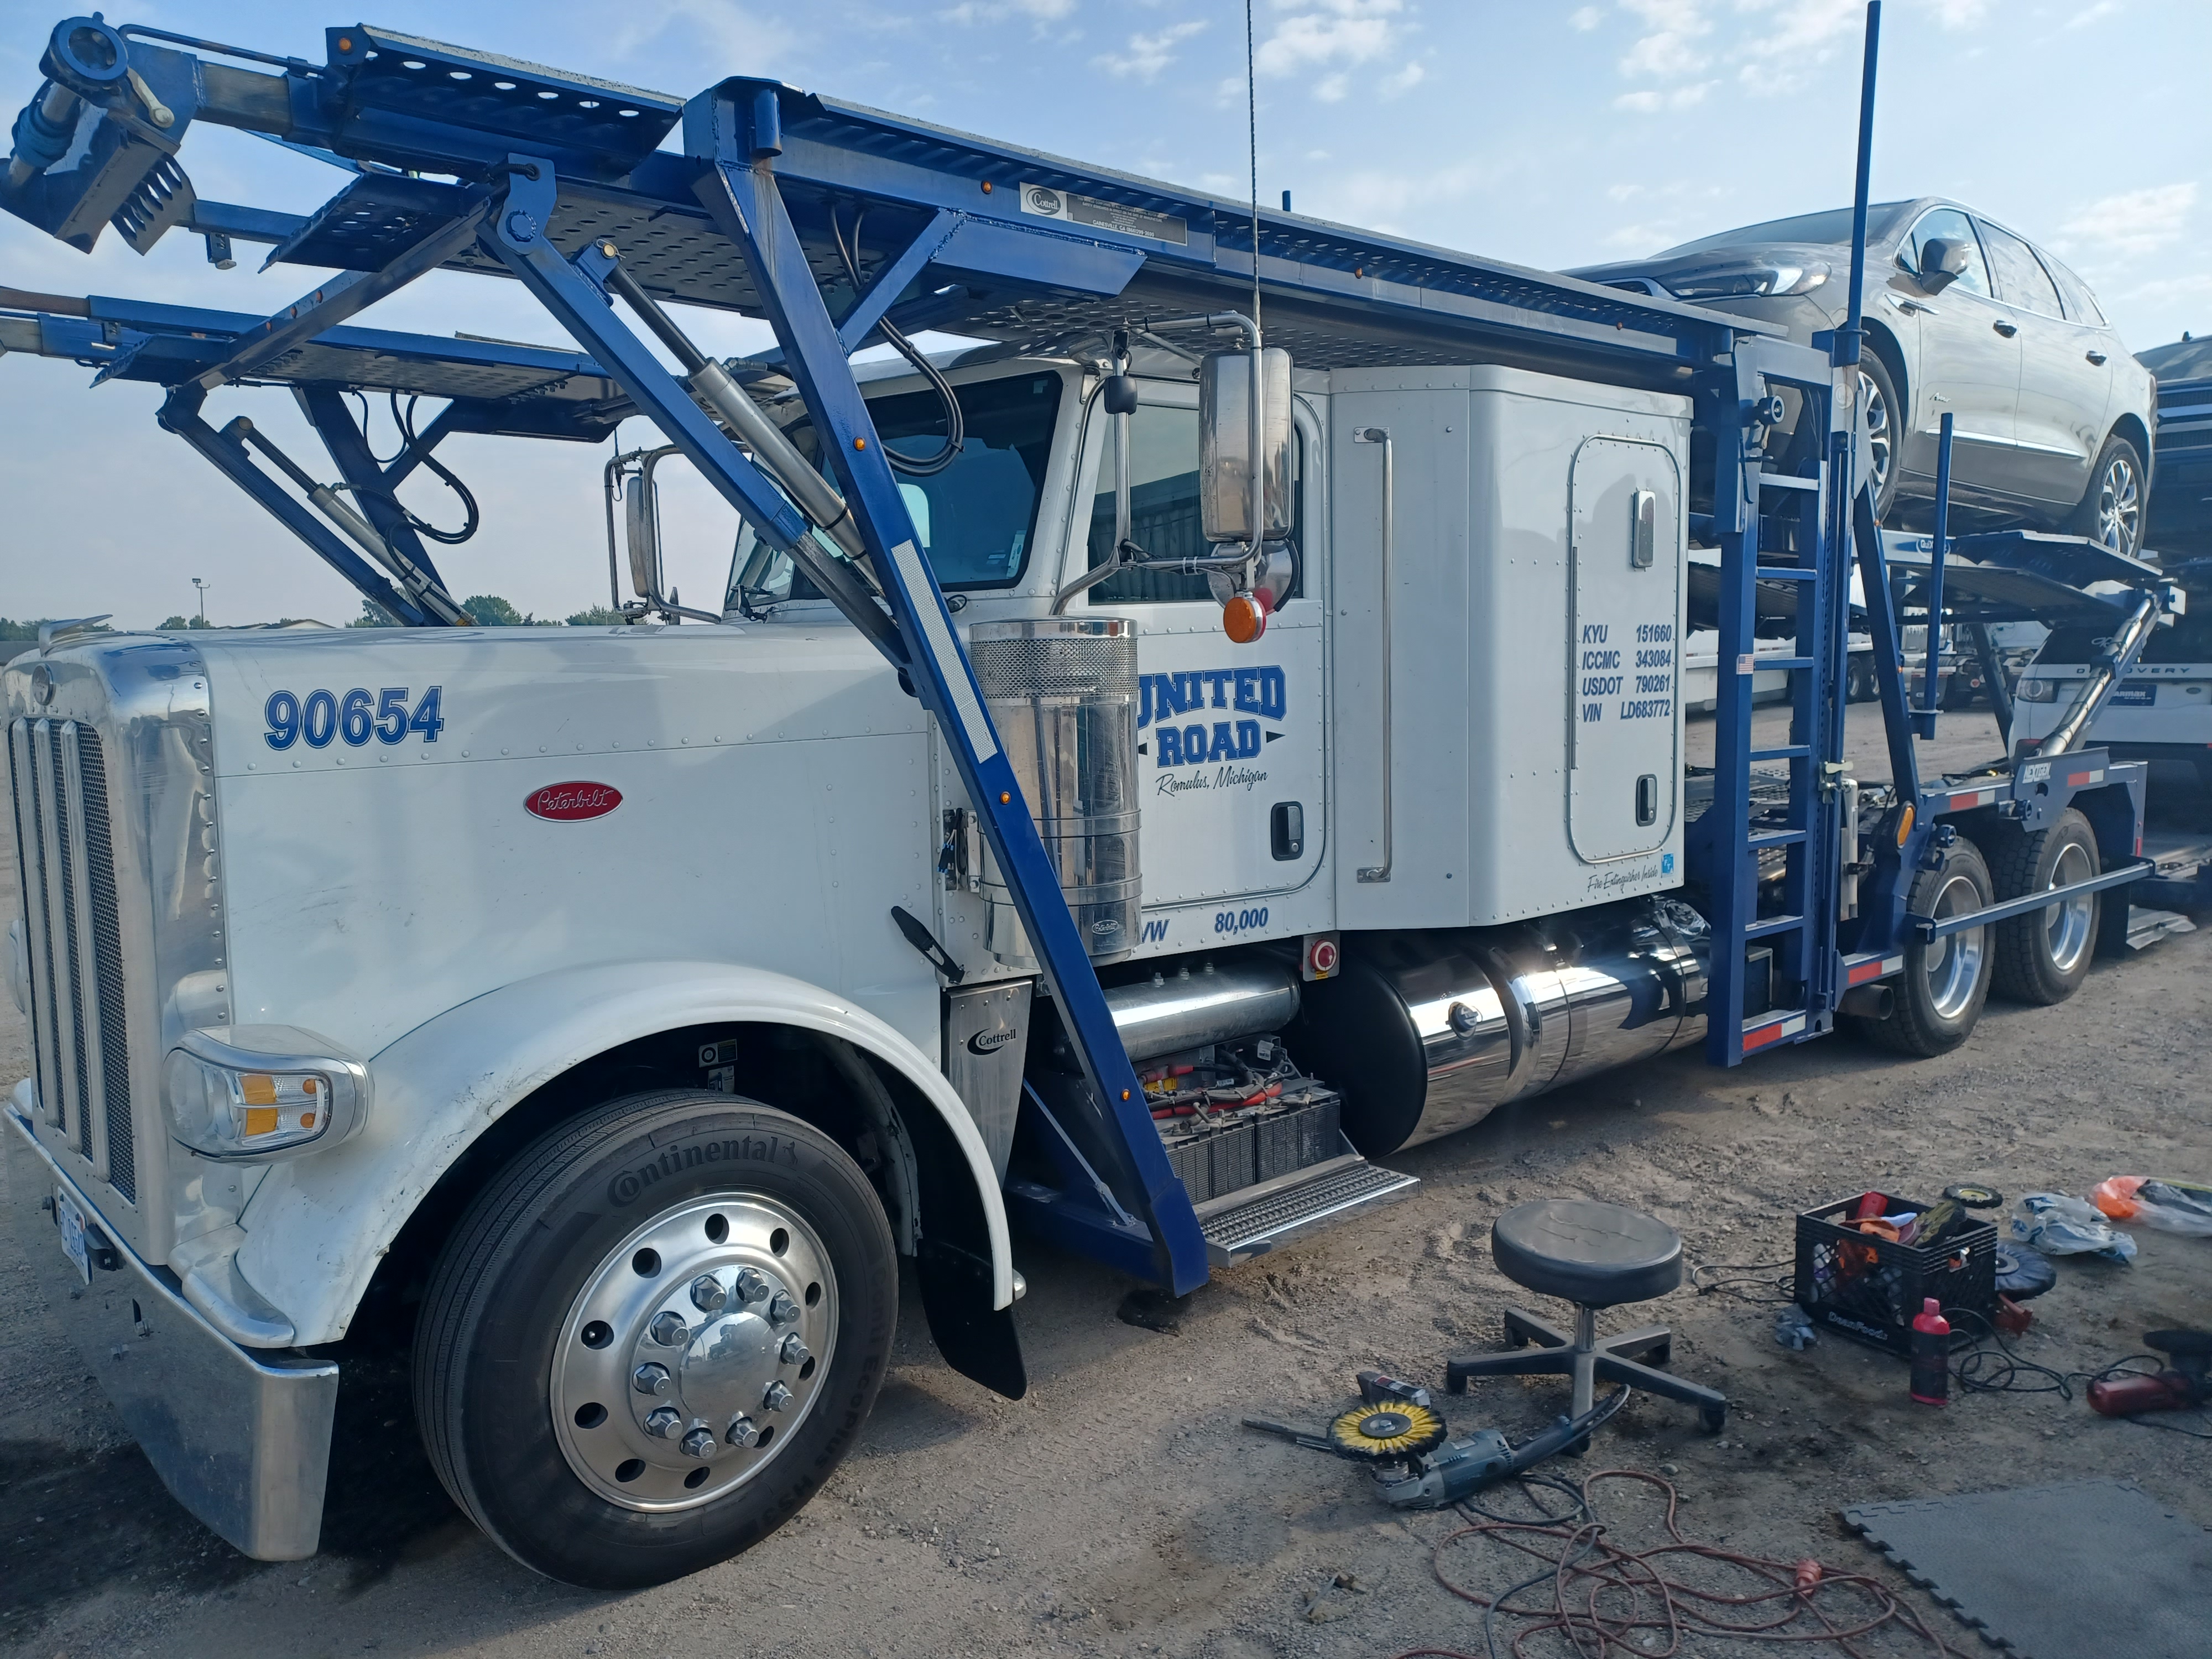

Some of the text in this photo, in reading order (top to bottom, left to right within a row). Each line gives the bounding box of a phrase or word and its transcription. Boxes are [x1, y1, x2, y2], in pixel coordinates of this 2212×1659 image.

[1034, 194, 1058, 210] Cottrell
[1583, 624, 1672, 644] KYU 151660
[1582, 649, 1671, 670] ICCMC 343084
[1583, 674, 1671, 697] USDOT 790261
[264, 686, 444, 750] 90654
[1583, 699, 1670, 723] VIN LD683772
[1156, 719, 1261, 768] ROAD
[1155, 765, 1269, 797] Romulus, Michigan
[538, 789, 614, 813] Peterbilt
[1588, 865, 1658, 893] Fire Extinguisher Inside
[1214, 906, 1269, 935] 80,000
[979, 1029, 1016, 1046] Cottrell
[607, 1135, 779, 1208] Continental
